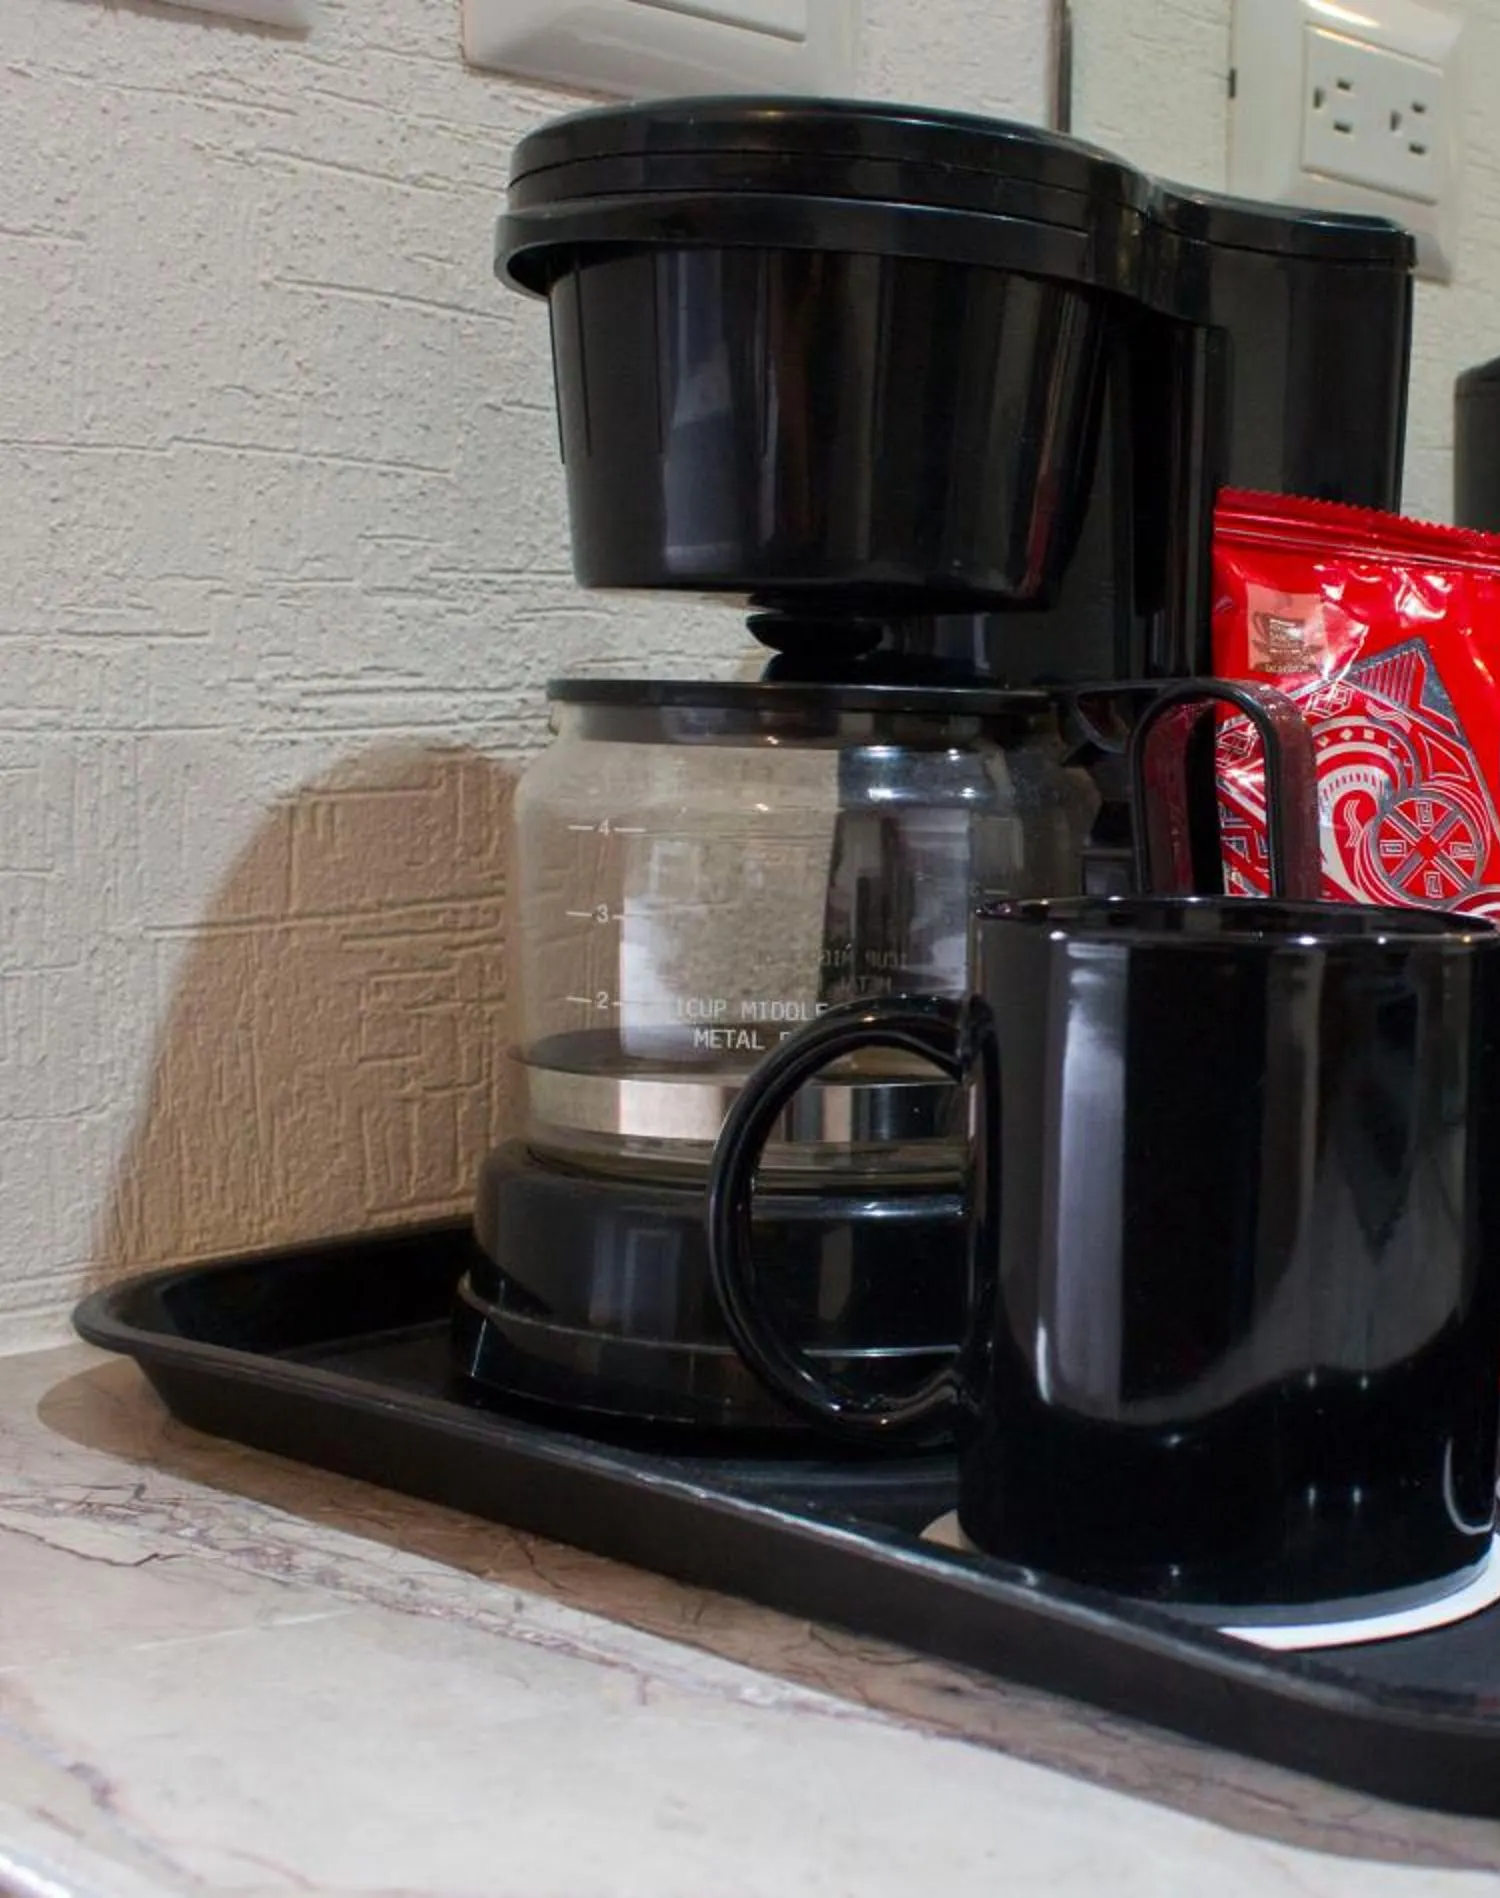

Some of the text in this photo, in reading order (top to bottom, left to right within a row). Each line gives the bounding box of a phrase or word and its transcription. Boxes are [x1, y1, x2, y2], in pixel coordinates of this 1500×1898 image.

[598, 819, 610, 836] 4
[597, 904, 609, 924] 3
[596, 991, 609, 1009] 2
[693, 1028, 765, 1050] METAL
